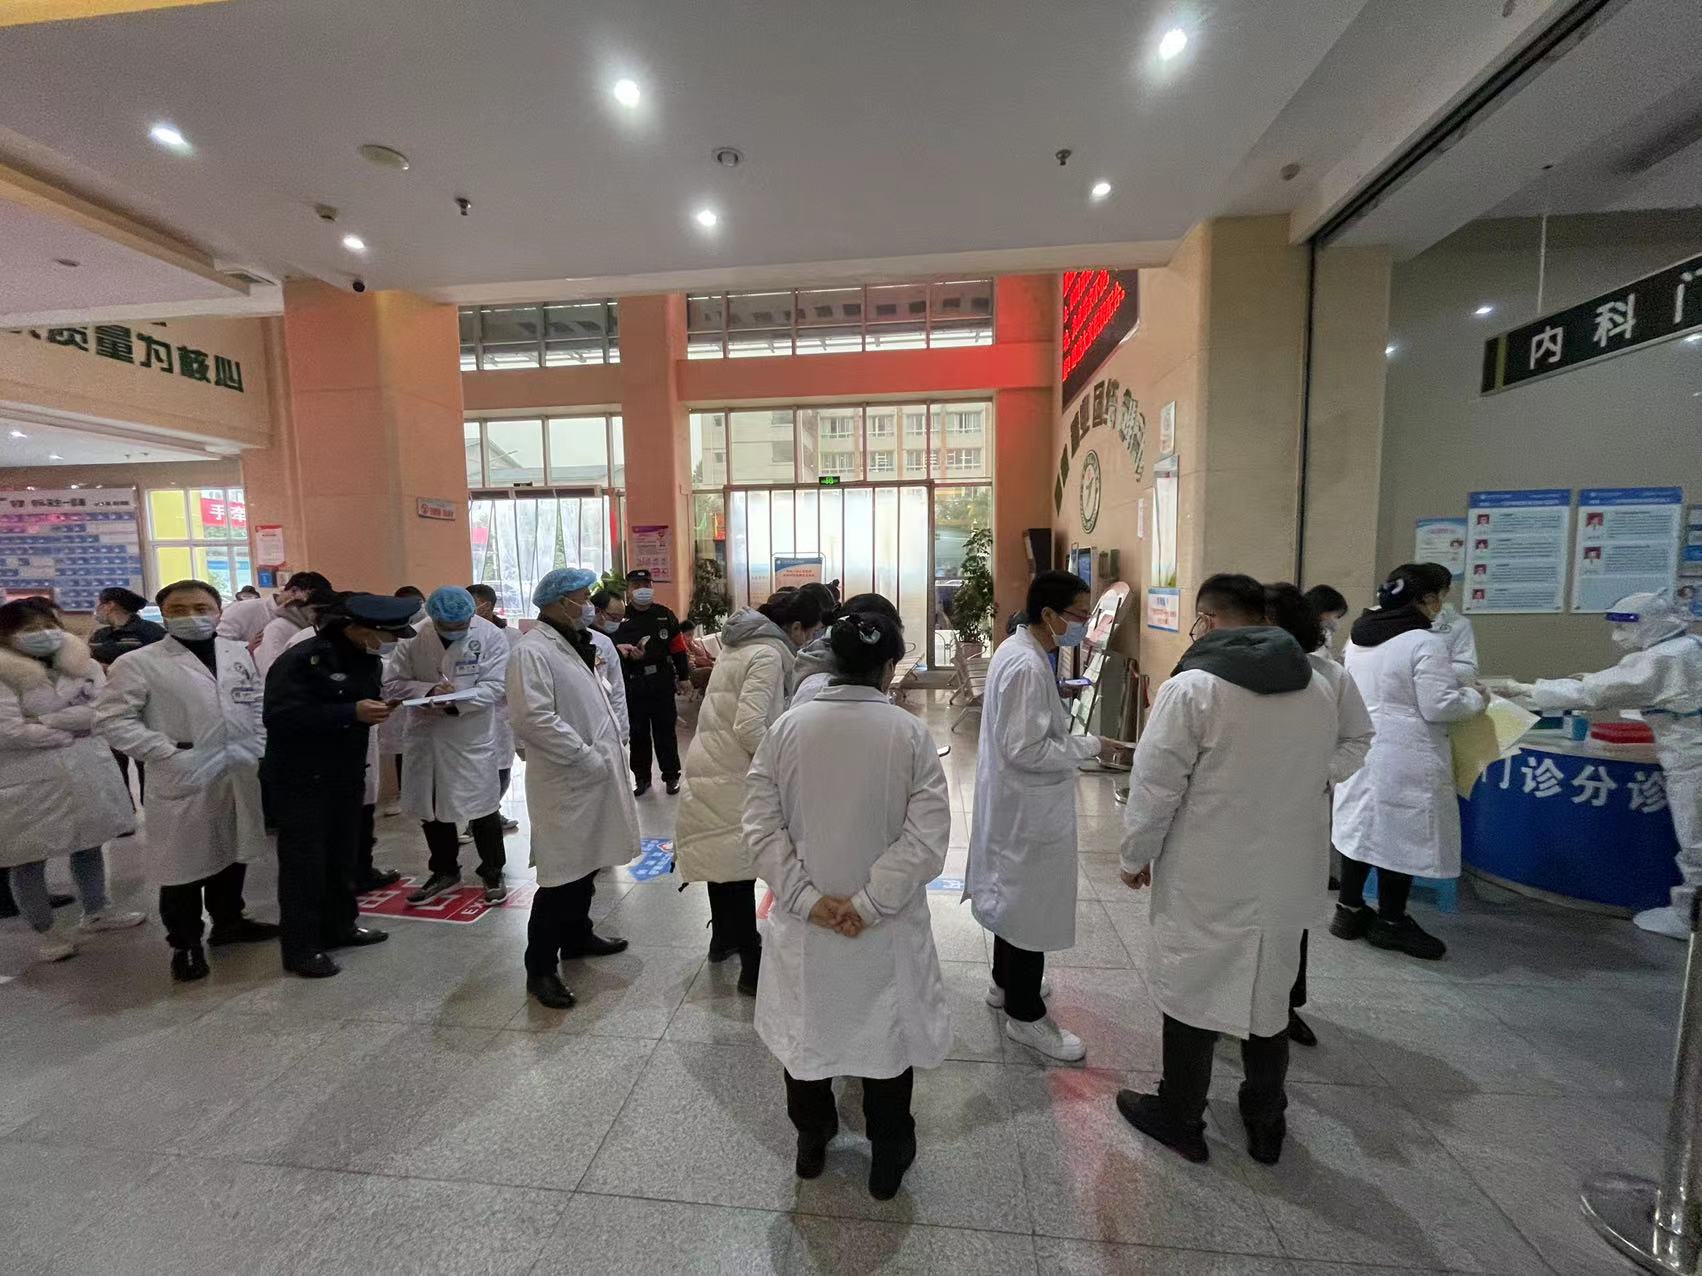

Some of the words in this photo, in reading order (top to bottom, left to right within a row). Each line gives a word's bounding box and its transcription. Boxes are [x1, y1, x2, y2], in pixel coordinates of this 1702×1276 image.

[8, 325, 244, 393] 质量为核心
